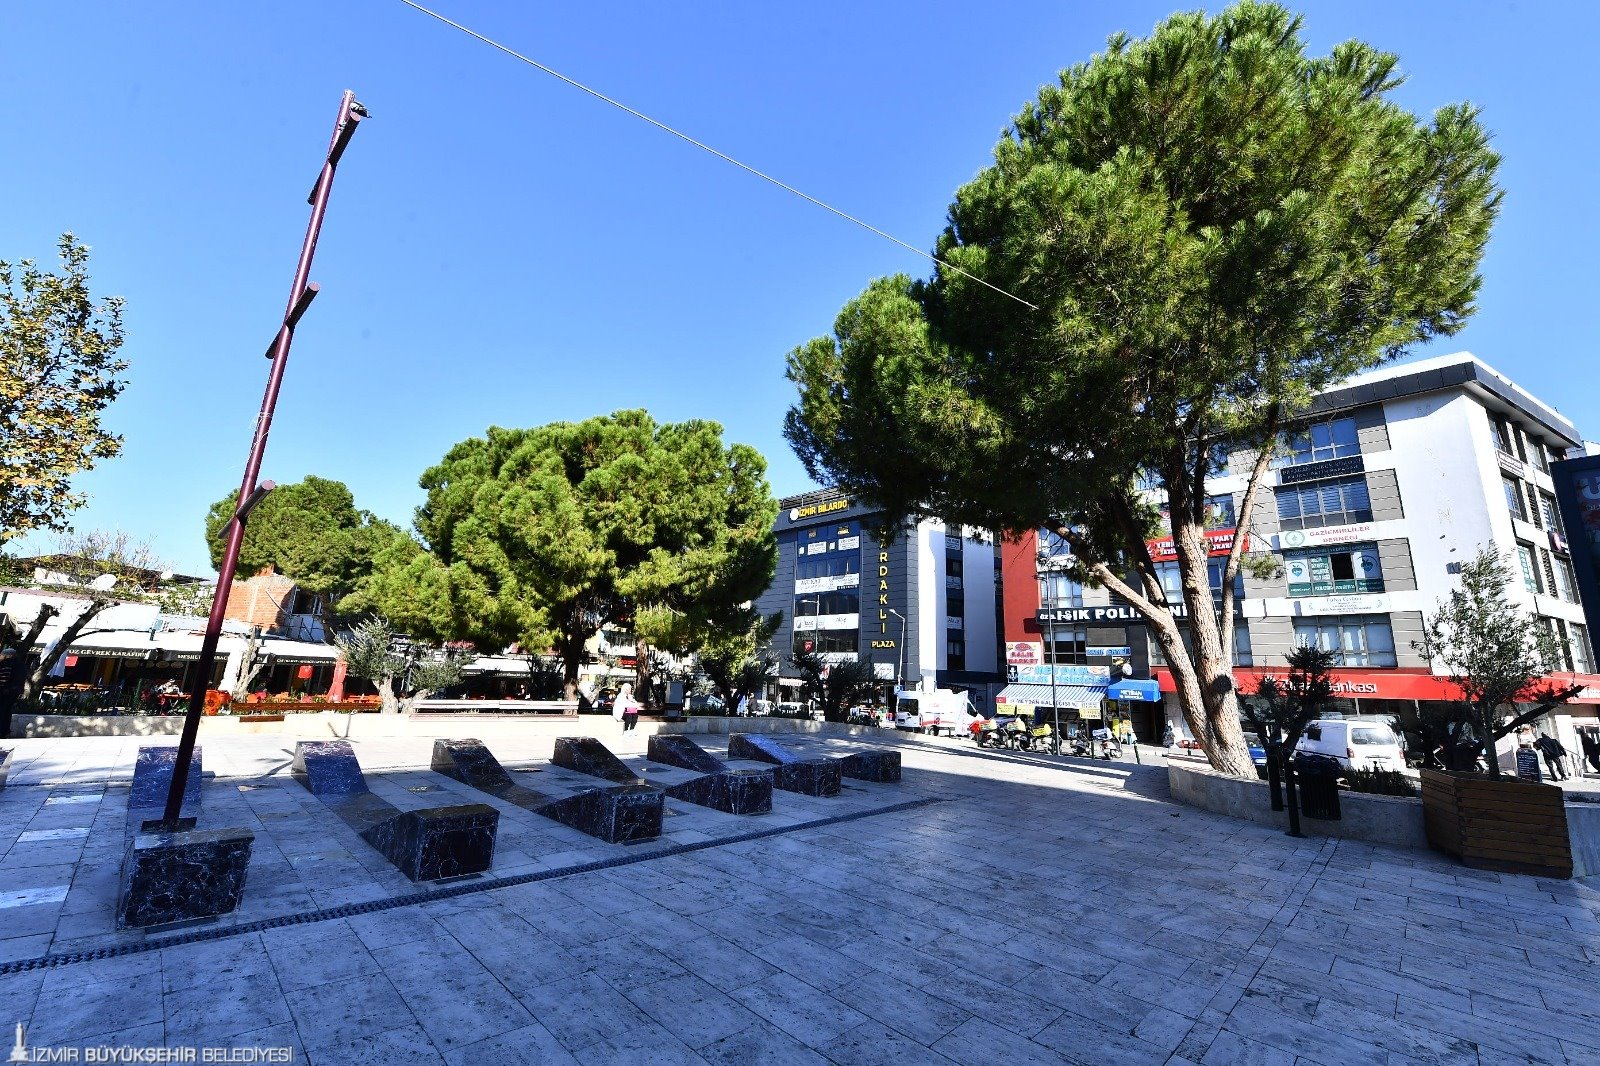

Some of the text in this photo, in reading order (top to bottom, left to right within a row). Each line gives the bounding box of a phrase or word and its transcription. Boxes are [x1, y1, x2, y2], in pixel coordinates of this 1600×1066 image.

[799, 500, 848, 518] İZMİR BİLARDO
[1310, 526, 1370, 537] GAZİEMİRLİLER
